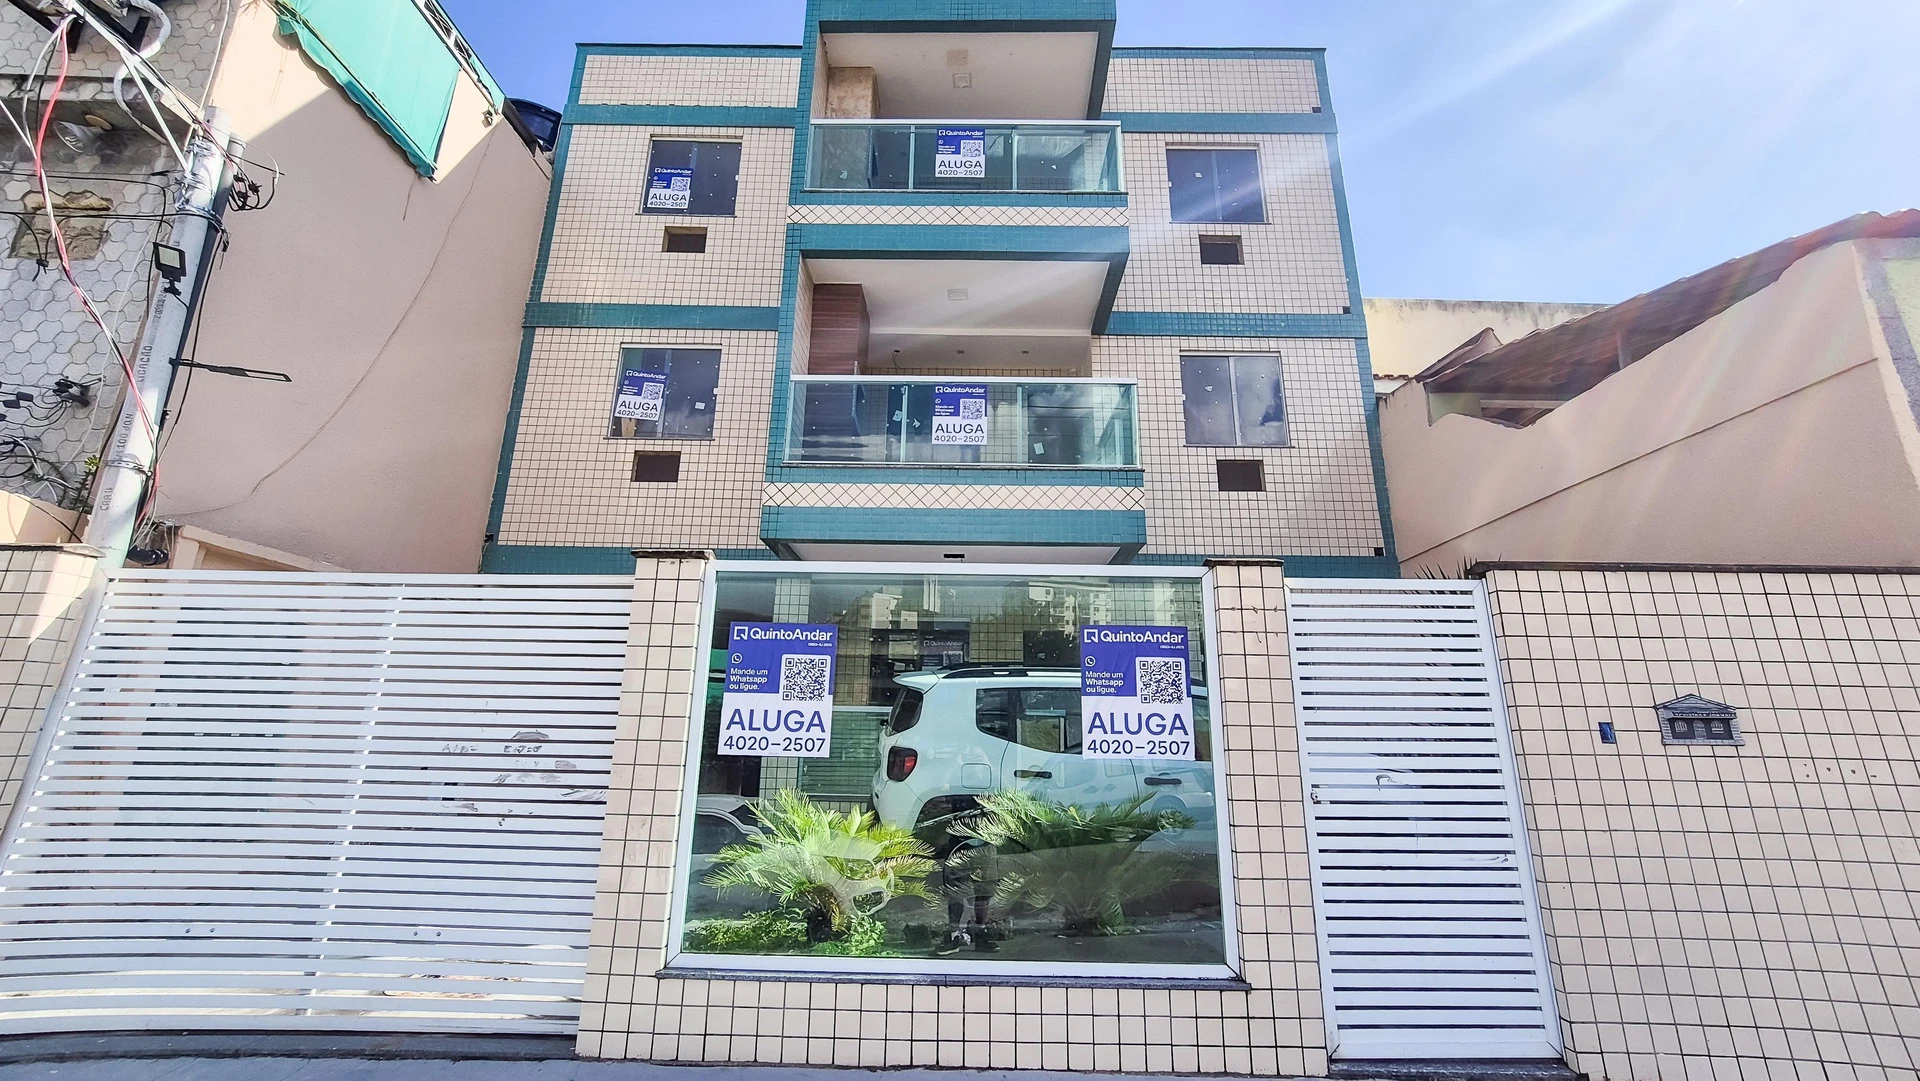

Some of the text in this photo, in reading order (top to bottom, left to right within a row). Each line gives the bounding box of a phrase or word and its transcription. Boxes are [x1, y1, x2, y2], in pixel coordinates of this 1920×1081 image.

[938, 160, 983, 169] ALUGA
[650, 193, 687, 202] ALUGA
[943, 386, 986, 394] QuintoAndar
[618, 400, 658, 412] ALUGA
[616, 409, 658, 419] 4020-2507
[935, 423, 985, 434] ALUGA
[934, 435, 985, 443] 4020-2507
[750, 627, 833, 642] QuintoAndar
[1100, 630, 1185, 643] QuintoAndar
[730, 675, 768, 684] Whatsapp
[1085, 678, 1124, 687] Whatsapp
[740, 683, 760, 692] ligue.
[1097, 686, 1117, 695] ligue.
[725, 708, 826, 733] ALUGA
[1087, 712, 1189, 736] ALUGA
[723, 735, 826, 753] 4020-2507
[1087, 739, 1190, 756] 4020-2507
